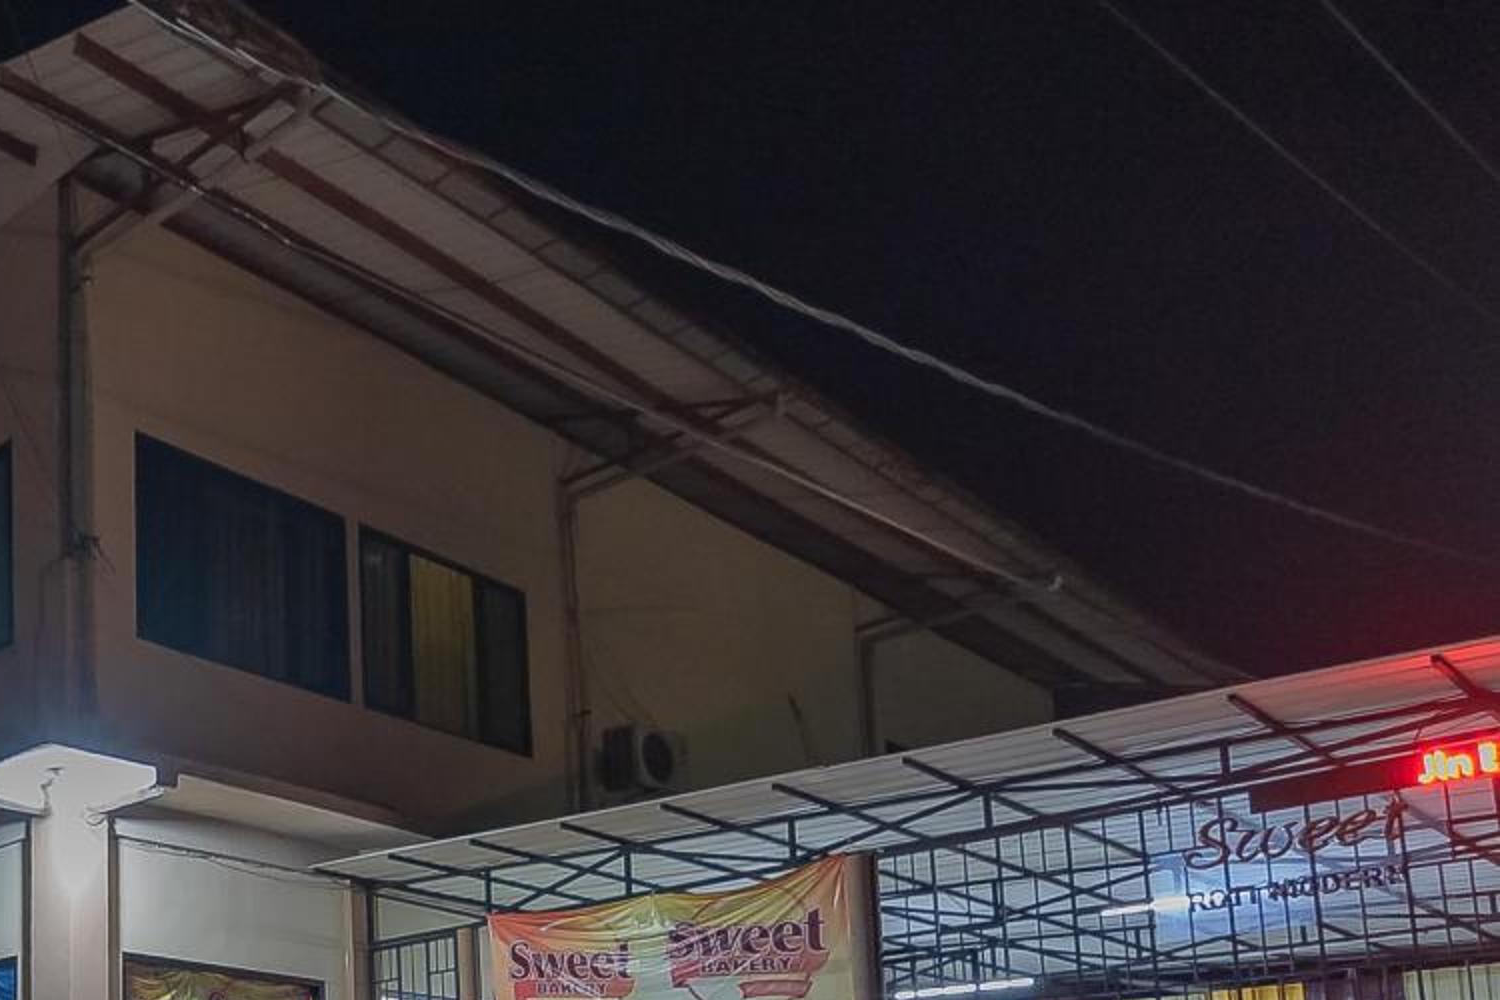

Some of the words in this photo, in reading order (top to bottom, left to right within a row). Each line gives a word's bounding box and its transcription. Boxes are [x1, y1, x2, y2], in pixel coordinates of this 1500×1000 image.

[1184, 795, 1409, 869] Sweet
[510, 937, 632, 979] Sweet
[665, 907, 827, 961] Sweet
[701, 956, 791, 974] BAKERY
